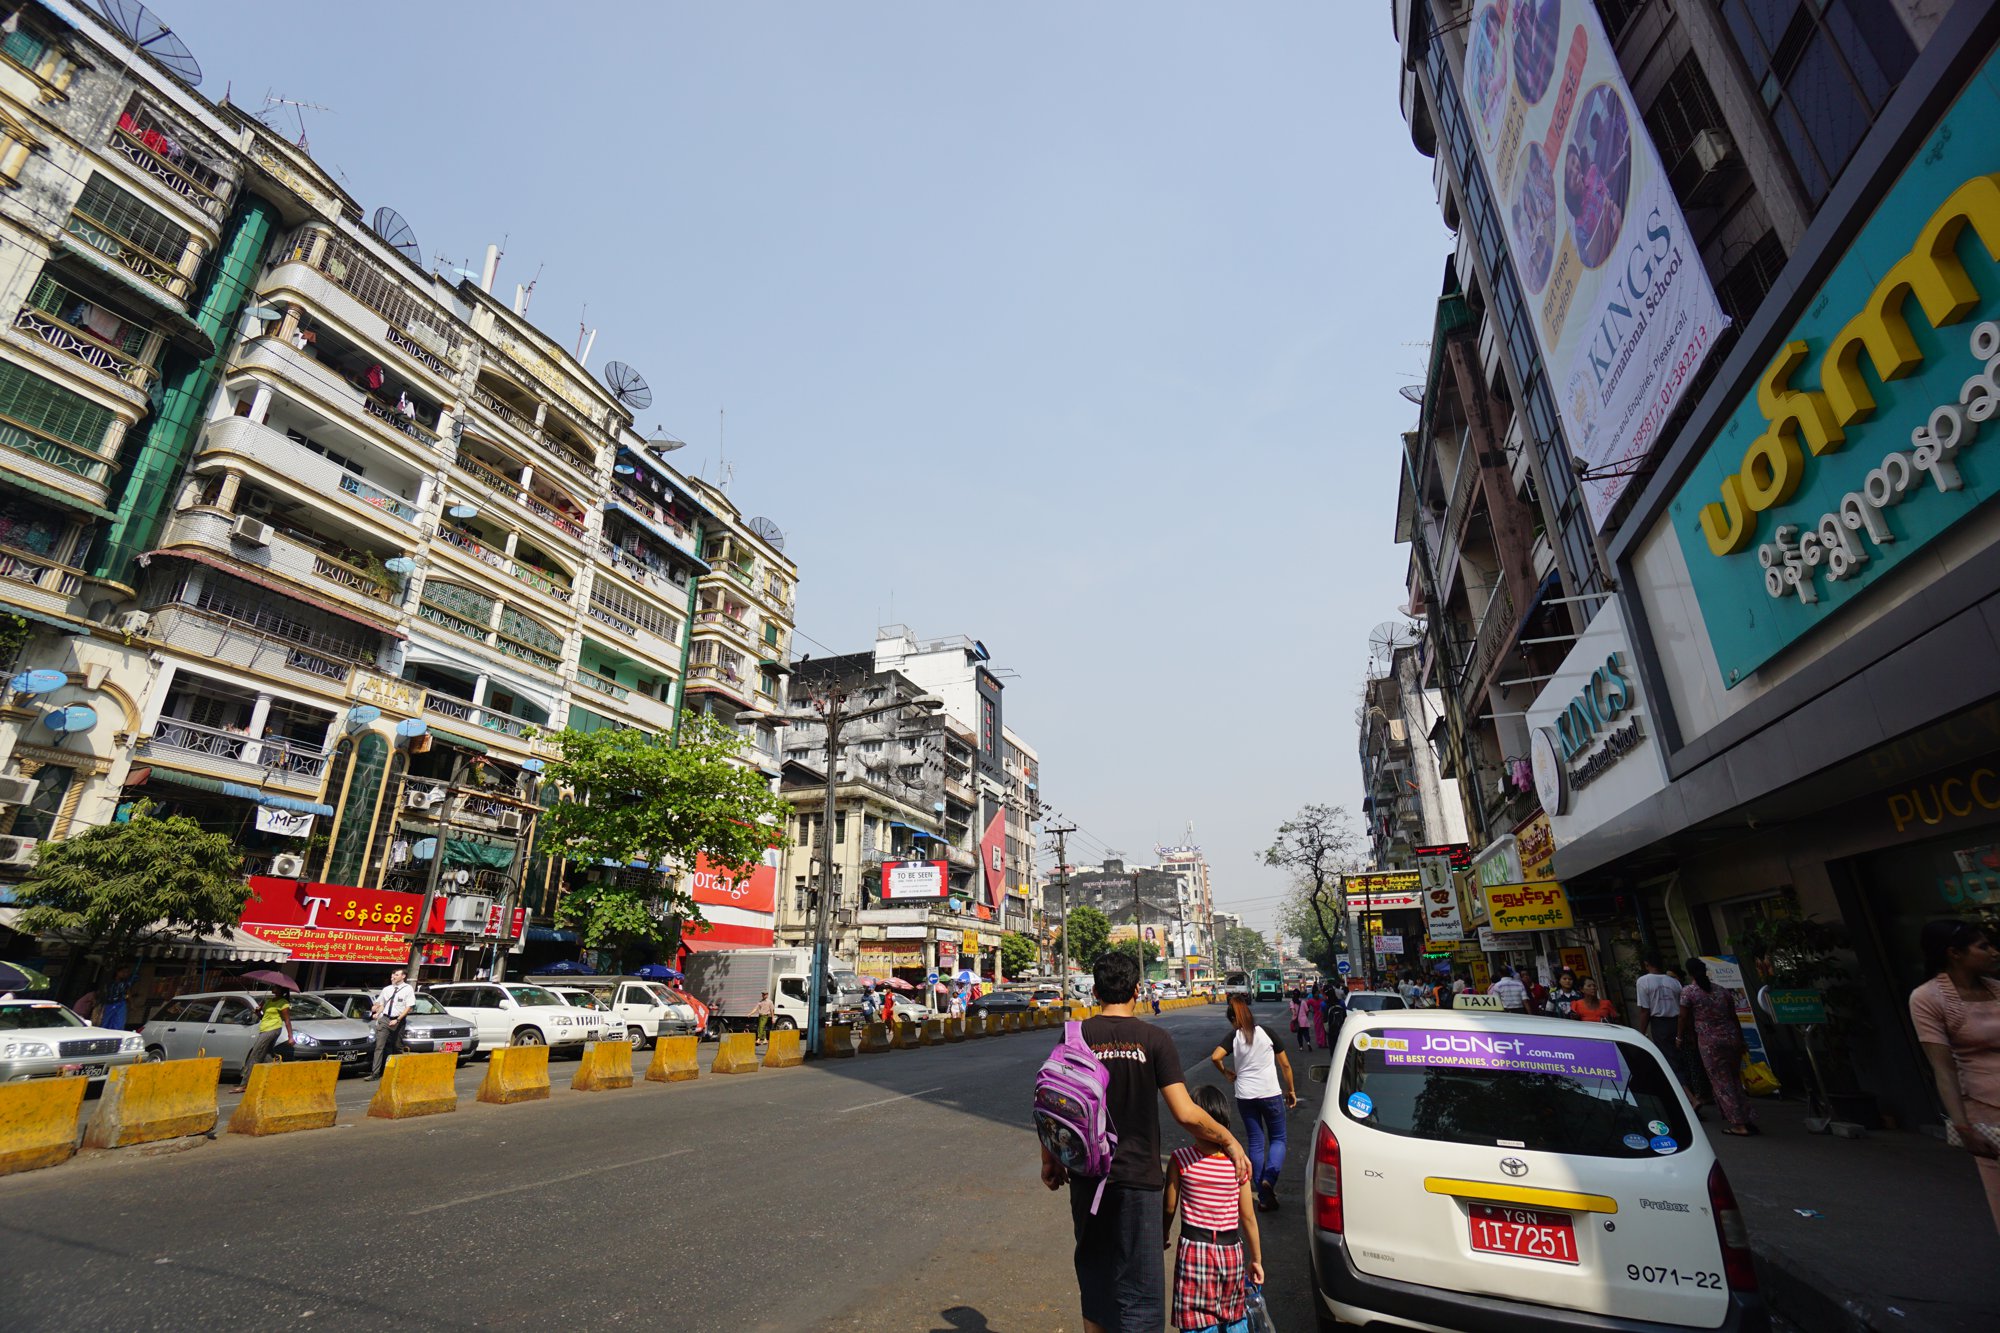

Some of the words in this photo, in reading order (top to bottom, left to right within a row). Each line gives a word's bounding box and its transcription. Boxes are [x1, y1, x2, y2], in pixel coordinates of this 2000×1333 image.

[1554, 65, 1576, 139] IGCSE
[1543, 289, 1558, 324] Part
[1554, 251, 1570, 286] time
[1587, 207, 1672, 387] KINGS
[1552, 279, 1574, 336] English
[1601, 320, 1649, 409] International
[1645, 247, 1683, 318] School
[1619, 414, 1631, 436] and
[1628, 371, 1657, 418] Enquiries,
[1653, 334, 1677, 371] Please
[1675, 313, 1688, 341] call
[1660, 325, 1708, 406] 01-382213
[1554, 652, 1630, 763] KINGS
[1569, 744, 1612, 790] International
[1609, 715, 1642, 757] School
[275, 814, 308, 827] MPT
[302, 896, 331, 929] T
[303, 930, 326, 939] Bran
[345, 932, 379, 942] Discount
[1461, 996, 1497, 1007] TAXI
[1387, 1040, 1407, 1050] OIL
[1388, 1054, 1404, 1063] THE
[1406, 1055, 1426, 1064] BEST
[1491, 1059, 1569, 1074] OPPORTUNITIES,
[1571, 1065, 1617, 1078] SALARIES
[1364, 1170, 1384, 1179] DX
[1504, 1209, 1537, 1225] YGN
[1639, 1199, 1690, 1213] Probox
[1627, 1264, 1722, 1289] 9071-22
